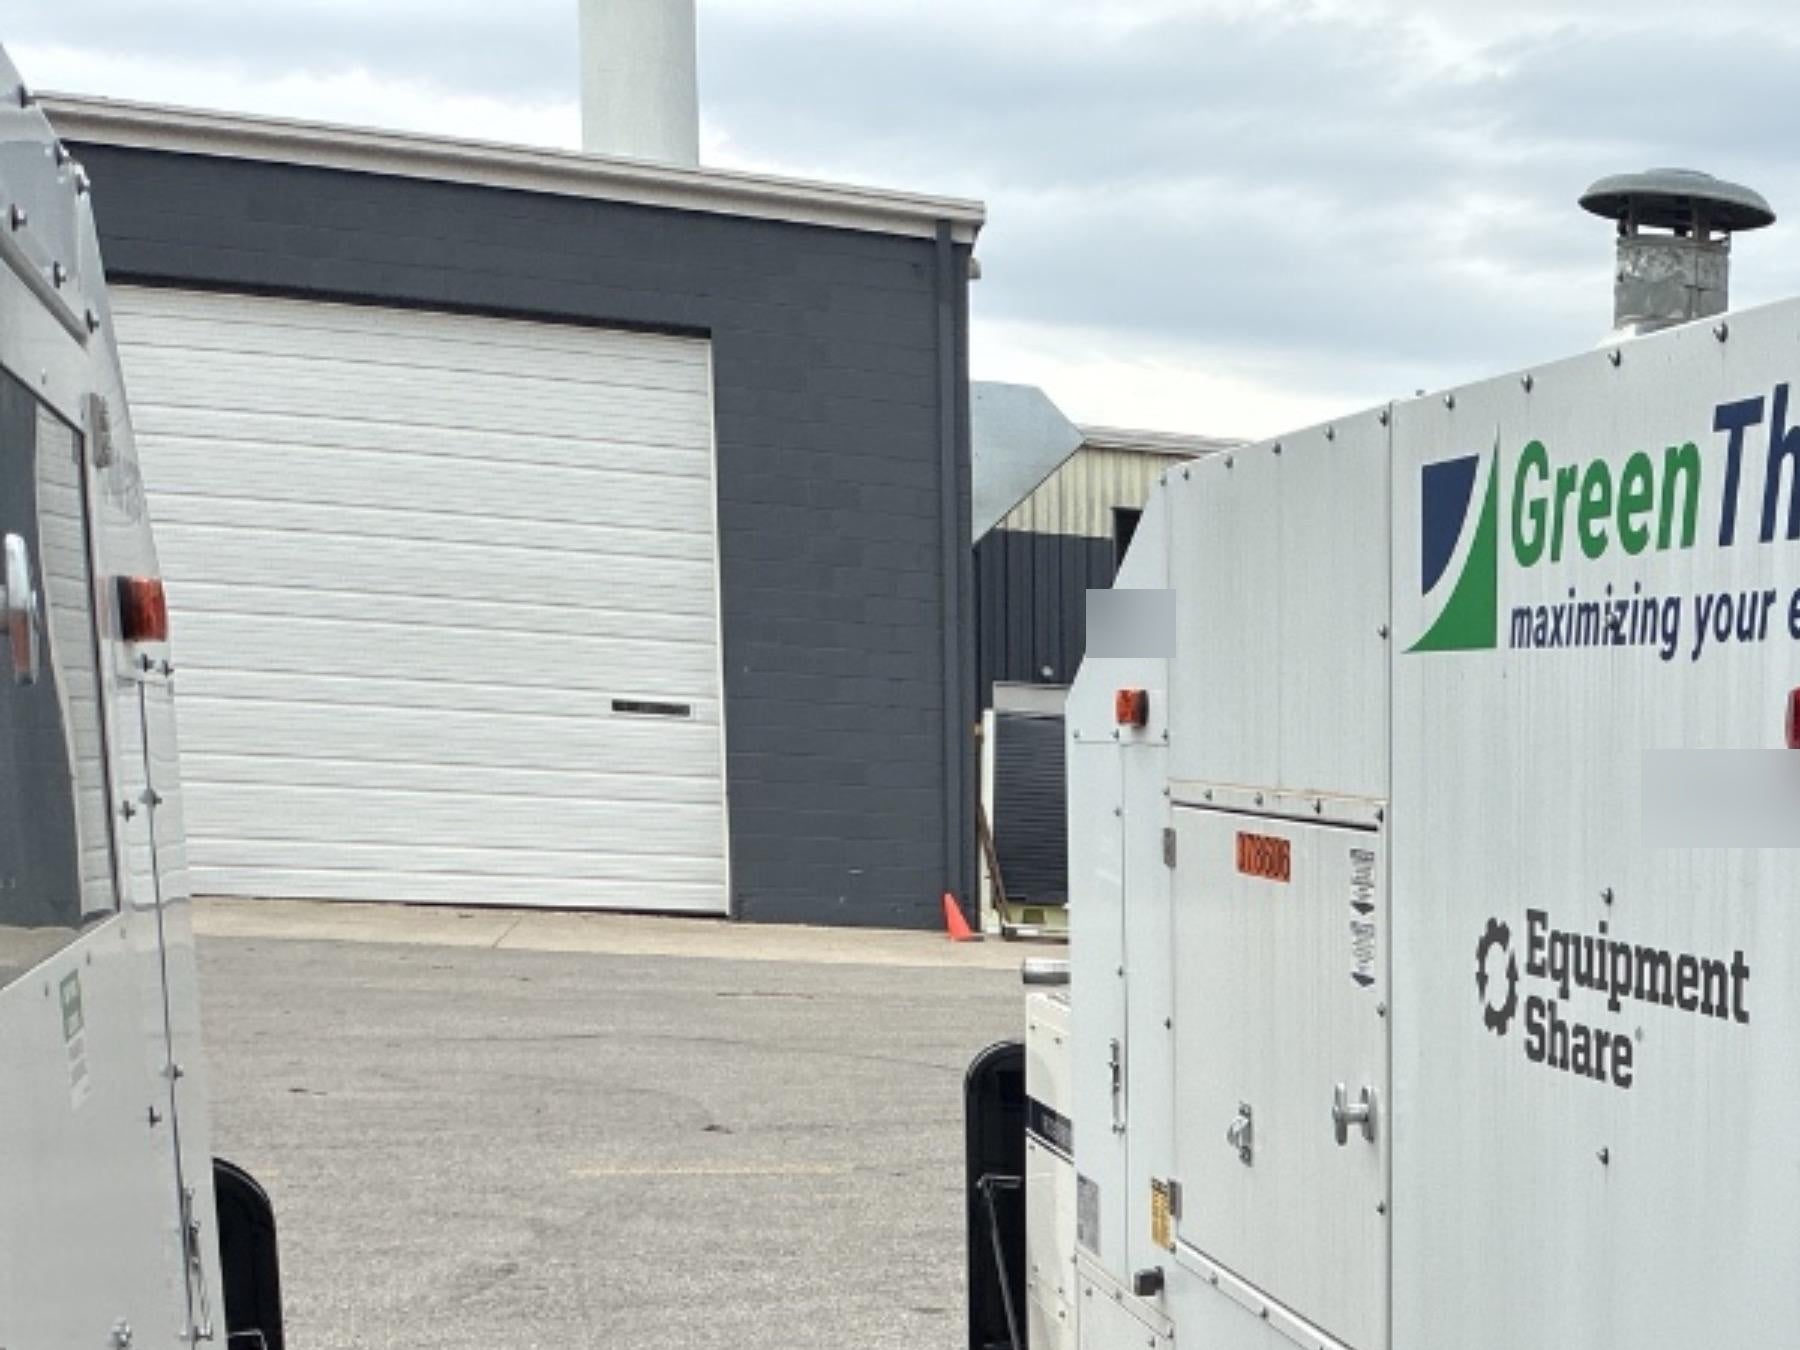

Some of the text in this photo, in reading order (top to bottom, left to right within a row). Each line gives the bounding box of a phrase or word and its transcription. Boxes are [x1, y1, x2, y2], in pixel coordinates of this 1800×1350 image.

[1510, 581, 1681, 661] maximizing
[1691, 589, 1776, 662] your
[1525, 908, 1750, 1024] Equipment
[1525, 994, 1632, 1089] Share
